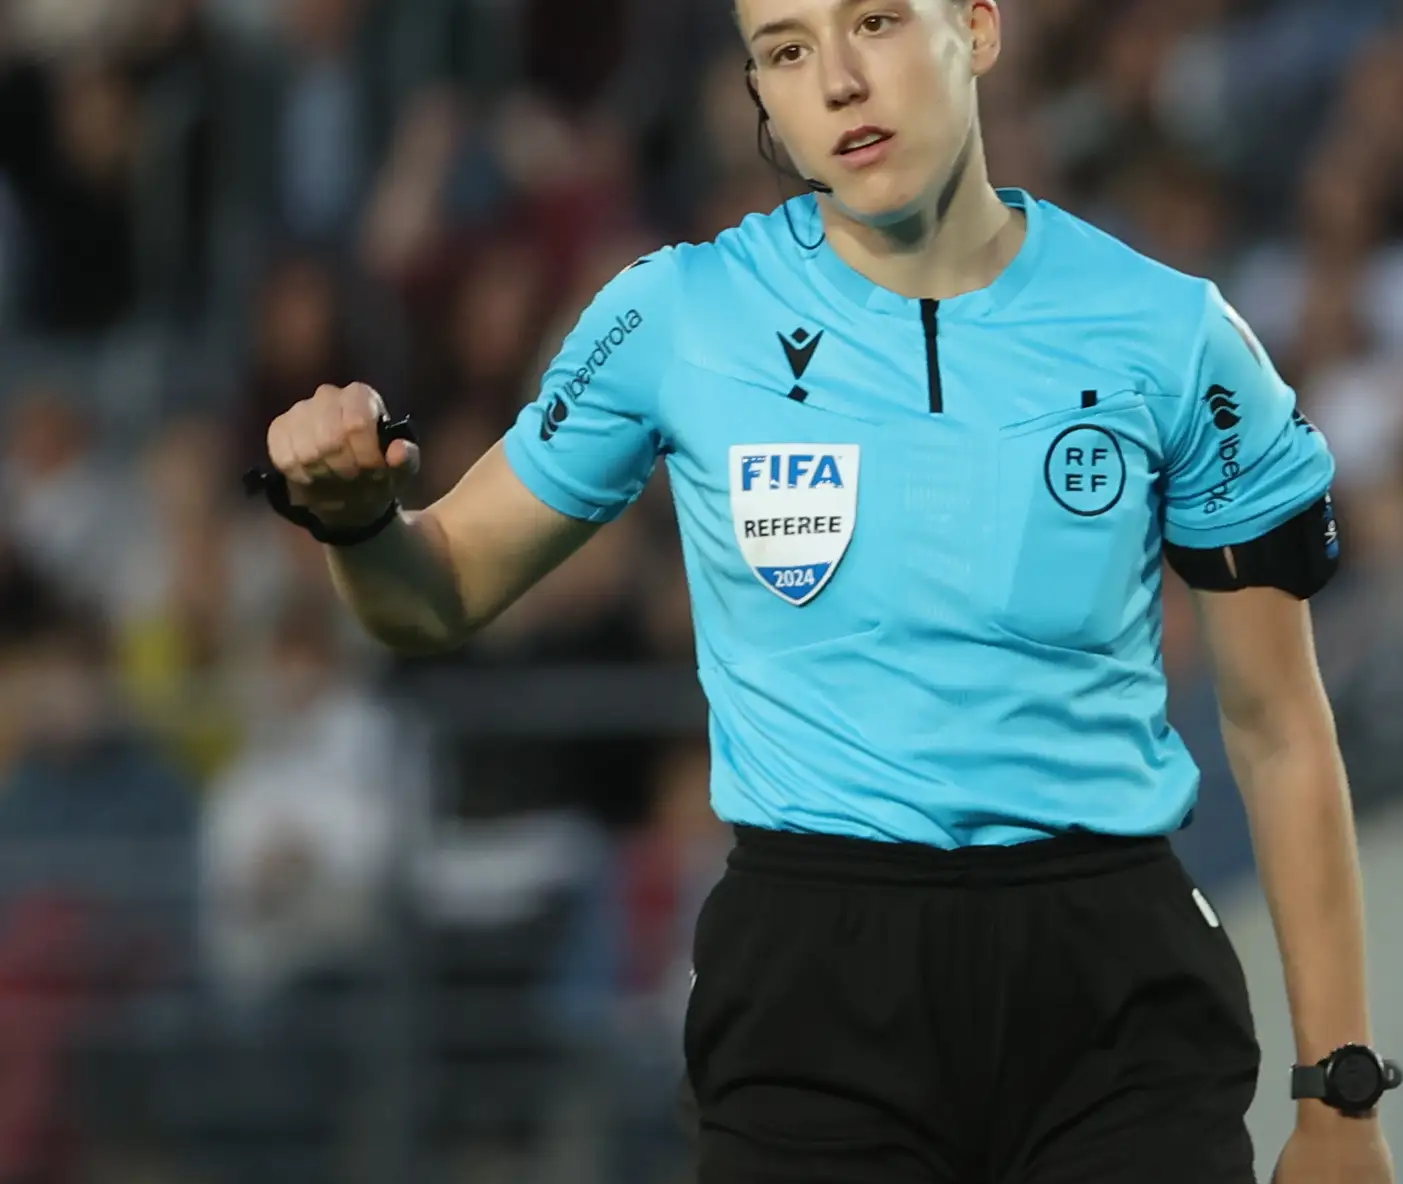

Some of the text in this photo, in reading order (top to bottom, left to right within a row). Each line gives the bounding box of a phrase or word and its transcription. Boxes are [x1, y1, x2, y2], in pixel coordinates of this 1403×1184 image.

[741, 454, 844, 491] FIFA
[744, 516, 841, 538] REFEREE
[773, 568, 815, 587] 2024
